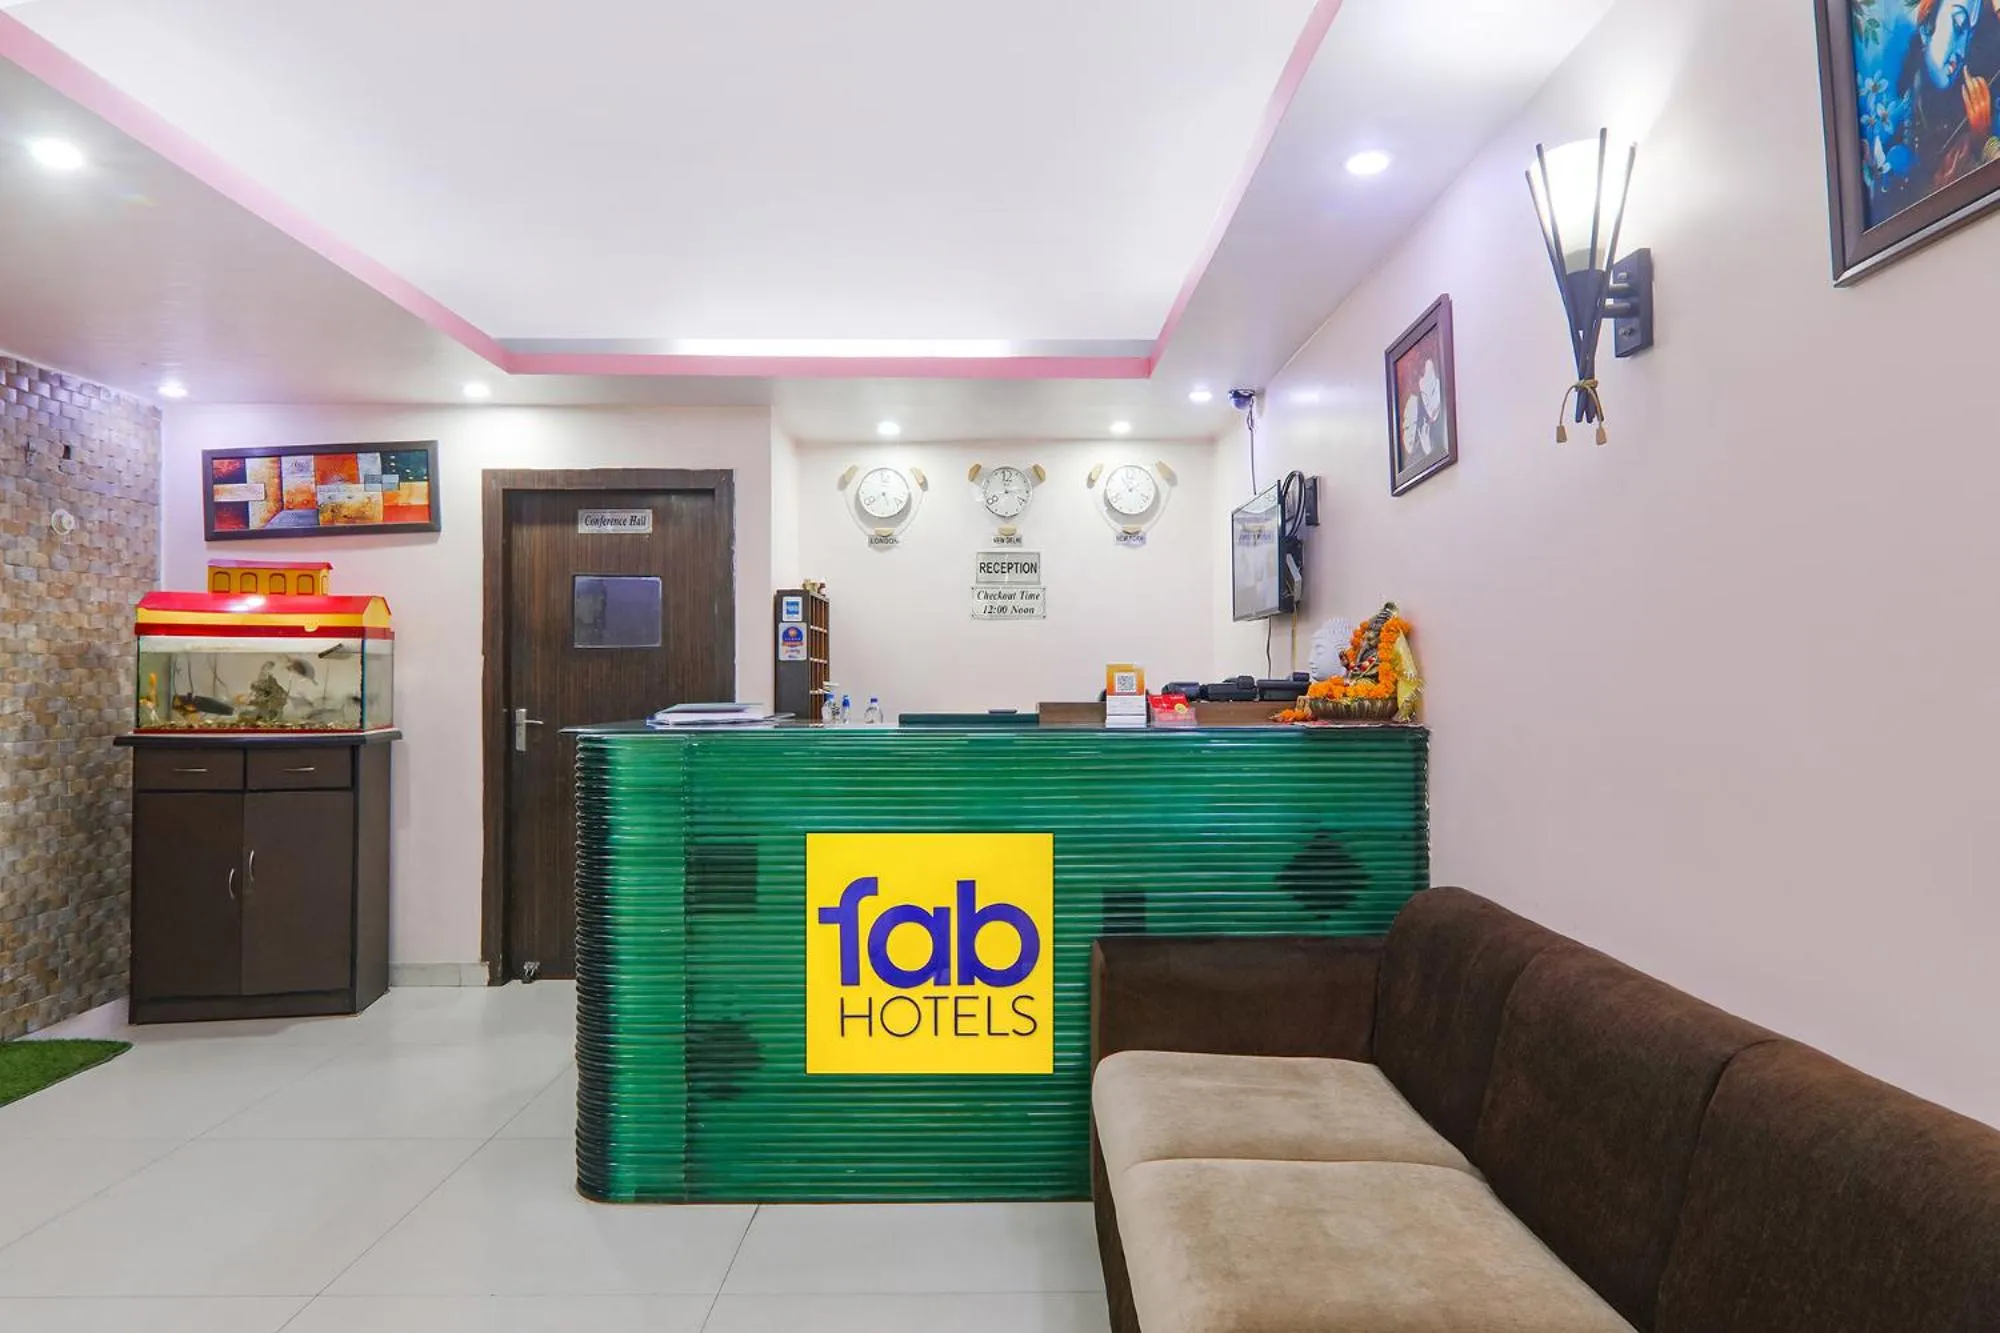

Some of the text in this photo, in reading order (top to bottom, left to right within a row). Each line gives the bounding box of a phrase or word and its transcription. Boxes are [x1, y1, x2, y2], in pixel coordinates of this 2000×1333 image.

[1002, 470, 1013, 482] 12
[584, 514, 647, 528] Conference Hall
[979, 561, 1038, 575] RECEPTION
[976, 590, 1041, 601] Checkout Time
[983, 604, 1035, 614] 12:00 Noon
[818, 876, 1040, 989] fab
[840, 995, 1038, 1038] HOTELS
